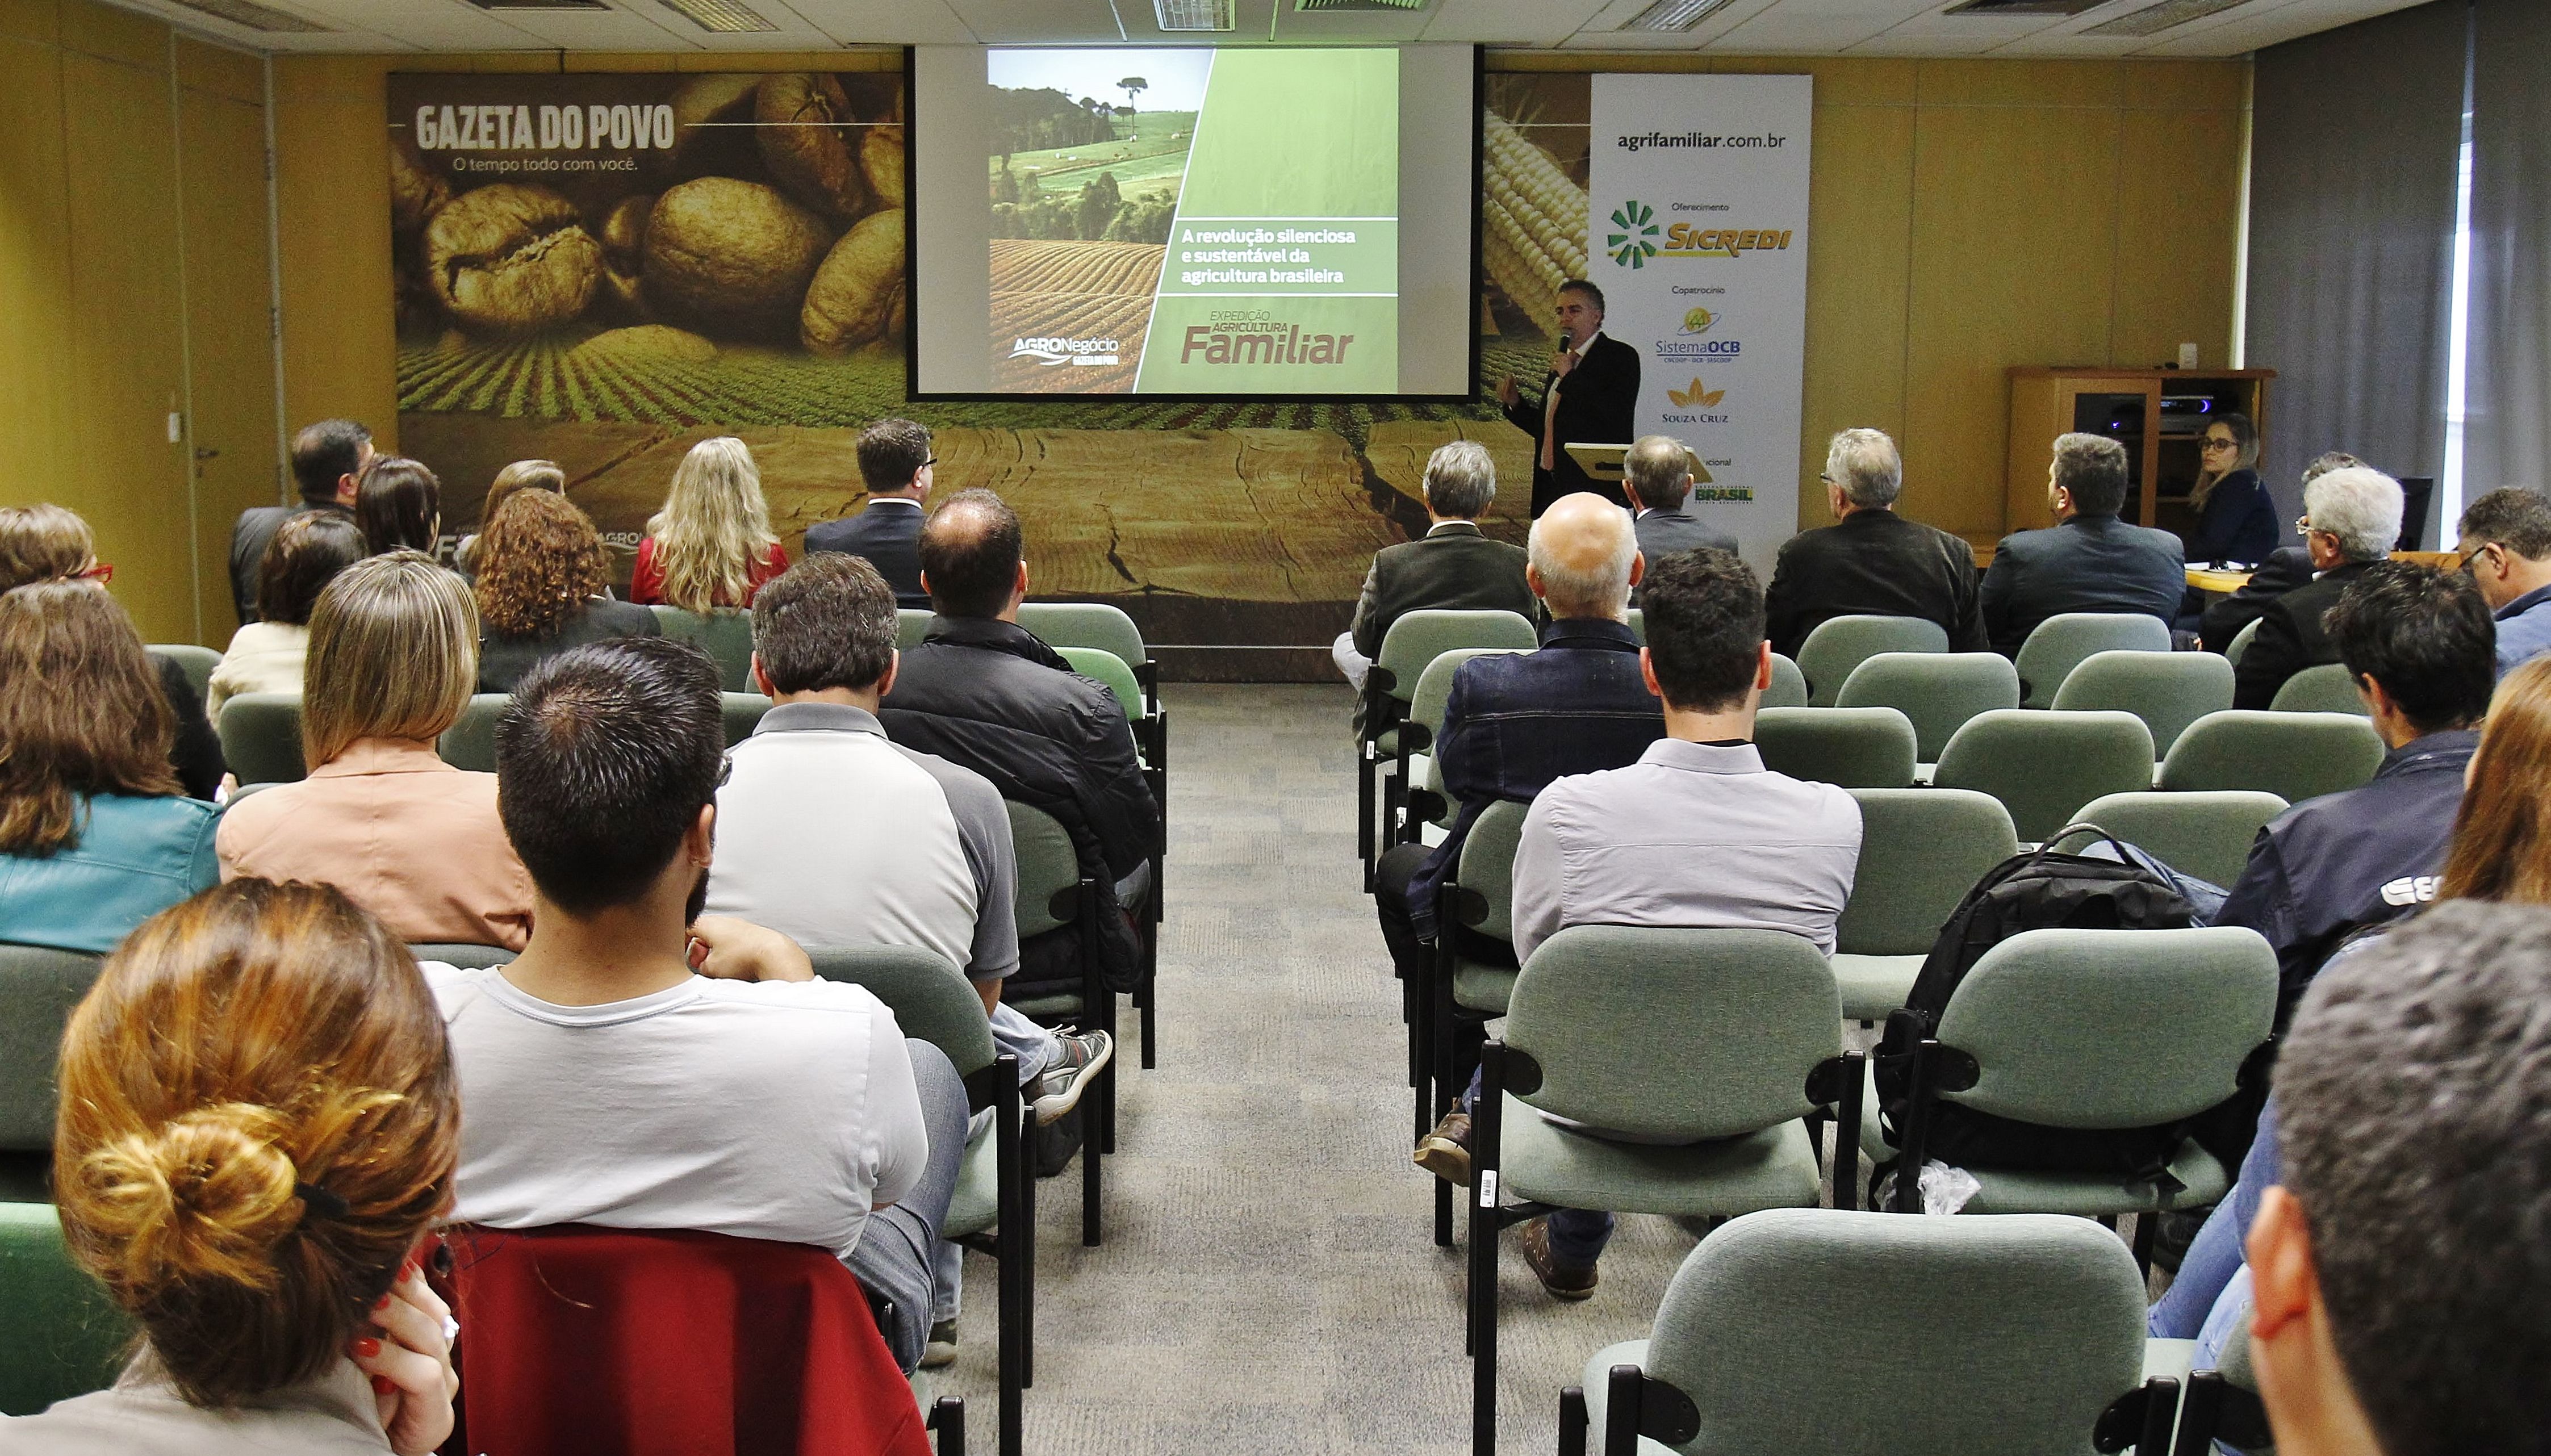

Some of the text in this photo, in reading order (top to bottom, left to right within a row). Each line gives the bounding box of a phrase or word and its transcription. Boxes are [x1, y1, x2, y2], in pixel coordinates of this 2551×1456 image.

[416, 104, 675, 149] GAZETA DO POVO
[1618, 132, 1786, 152] agrifamiliar.com.br
[453, 156, 638, 173] O tempo todo com você.
[1671, 203, 1729, 211] Oferecimento
[1181, 228, 1356, 247] A revolução silenciosa
[1181, 248, 1310, 263] e sustentável da
[1181, 268, 1344, 286] agricultura brasileira
[1210, 309, 1270, 321] EXPEDIÇÃO
[1212, 323, 1288, 332] AGRICULTURA
[1013, 337, 1119, 354] AGRONegócio
[1181, 324, 1354, 364] Familiar
[1656, 340, 1740, 353] SistemaOCB
[1662, 413, 1728, 423] SOUZA CRUZ
[1696, 489, 1753, 501] BRASIL
